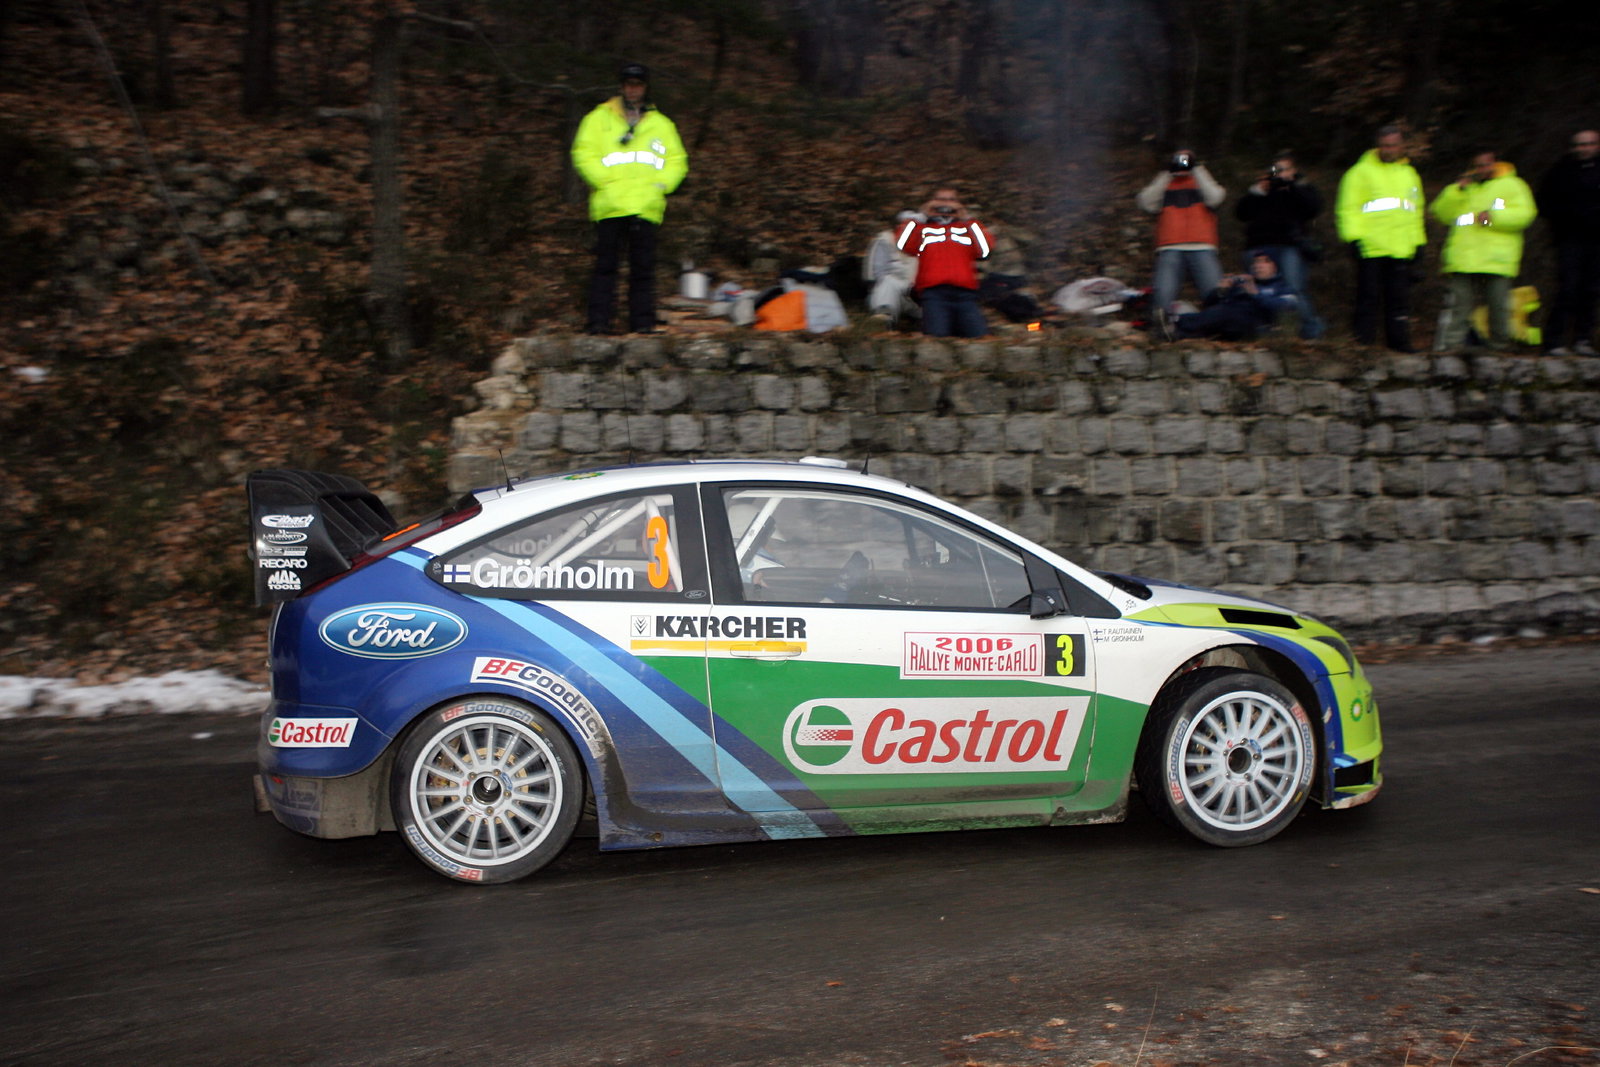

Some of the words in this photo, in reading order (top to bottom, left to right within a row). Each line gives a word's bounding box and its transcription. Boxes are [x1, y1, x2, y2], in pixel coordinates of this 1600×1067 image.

[259, 558, 308, 569] RECARO
[647, 516, 669, 589] 3
[268, 569, 301, 585] MAC
[473, 558, 634, 590] Grönholm
[347, 611, 438, 648] Ford
[655, 615, 807, 639] KÄRCHER
[910, 641, 951, 672] RALLYE
[935, 637, 1013, 654] 2006
[1056, 634, 1074, 676] 3
[443, 702, 532, 722] BFGoodrich
[281, 722, 350, 743] Castrol
[861, 708, 1070, 765] Castrol
[1168, 720, 1187, 800] BFGoodrich
[407, 827, 481, 881] BFGoodrich
